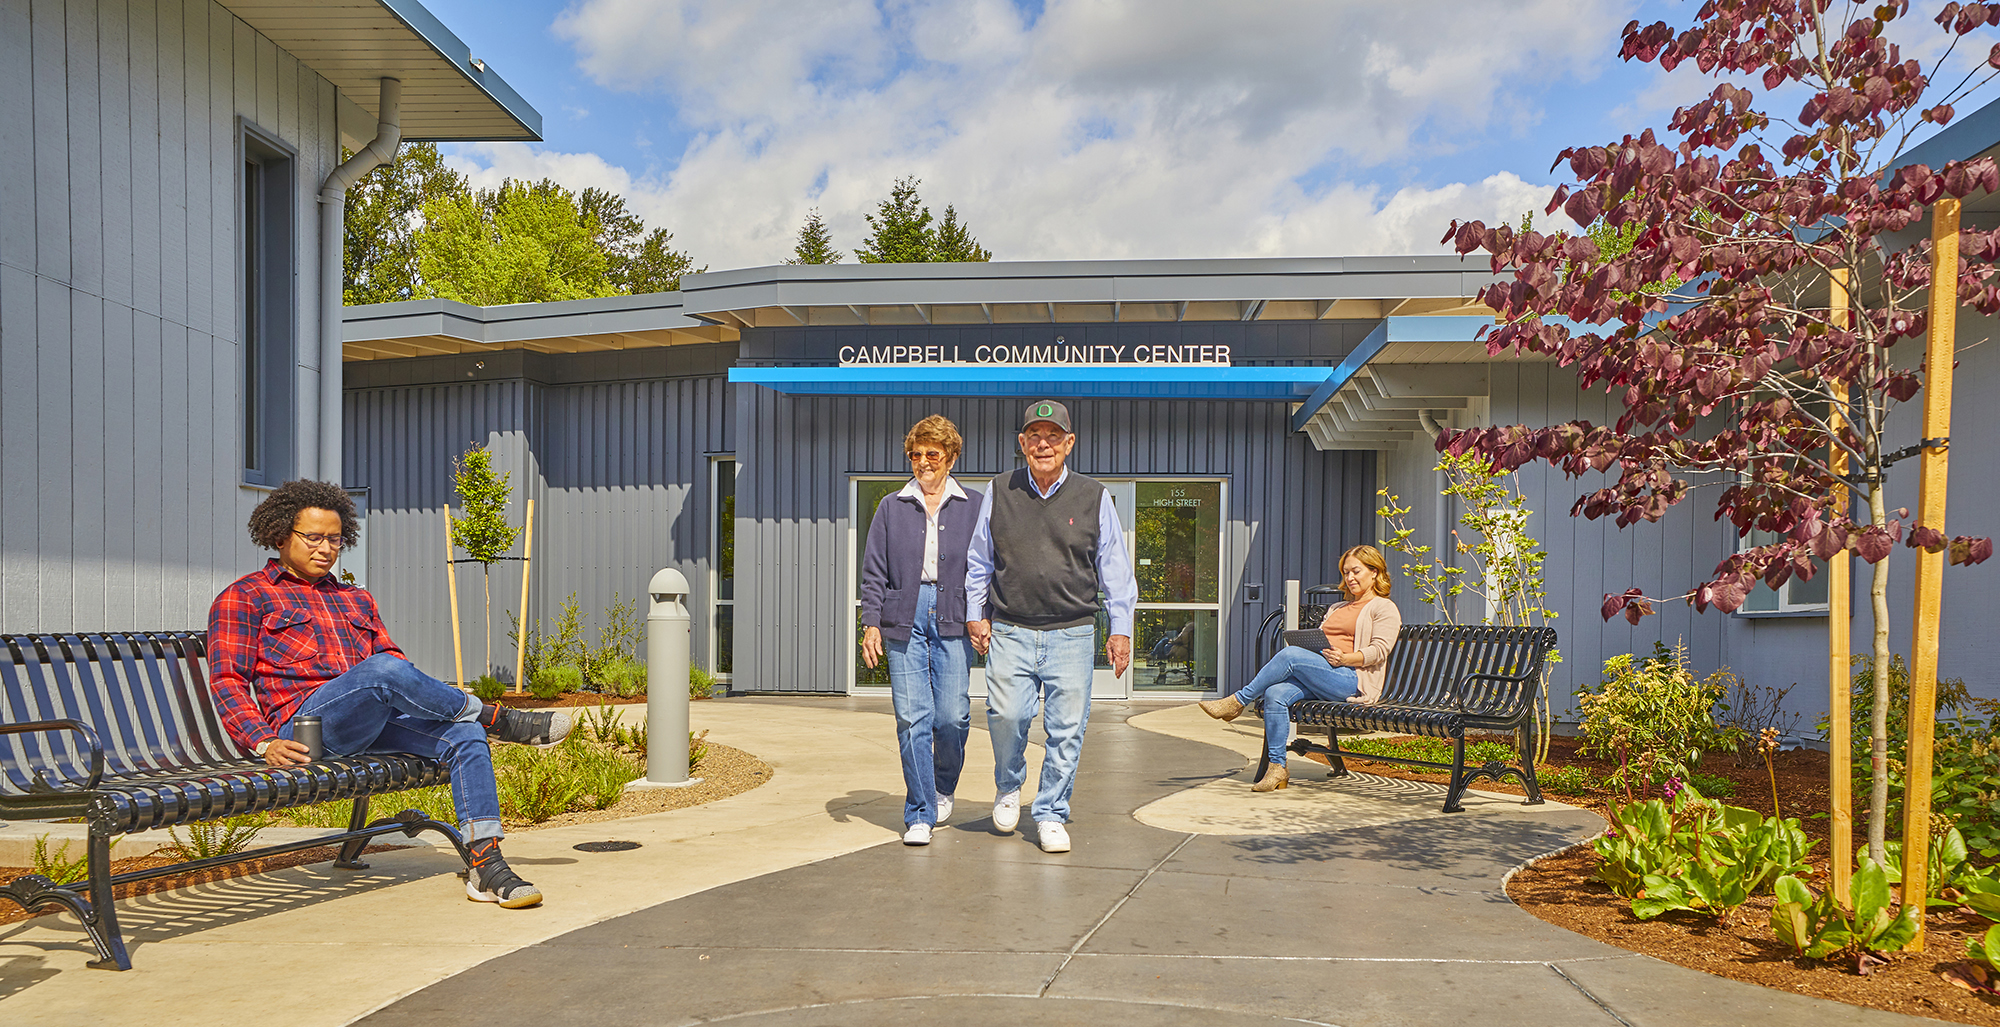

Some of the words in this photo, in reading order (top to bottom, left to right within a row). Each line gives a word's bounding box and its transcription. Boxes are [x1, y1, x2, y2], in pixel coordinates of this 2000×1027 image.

[838, 345, 966, 365] CAMPBELL
[974, 345, 1126, 365] COMMUNITY
[1132, 344, 1232, 365] CENTER
[1036, 404, 1053, 417] O
[1170, 489, 1185, 497] 155
